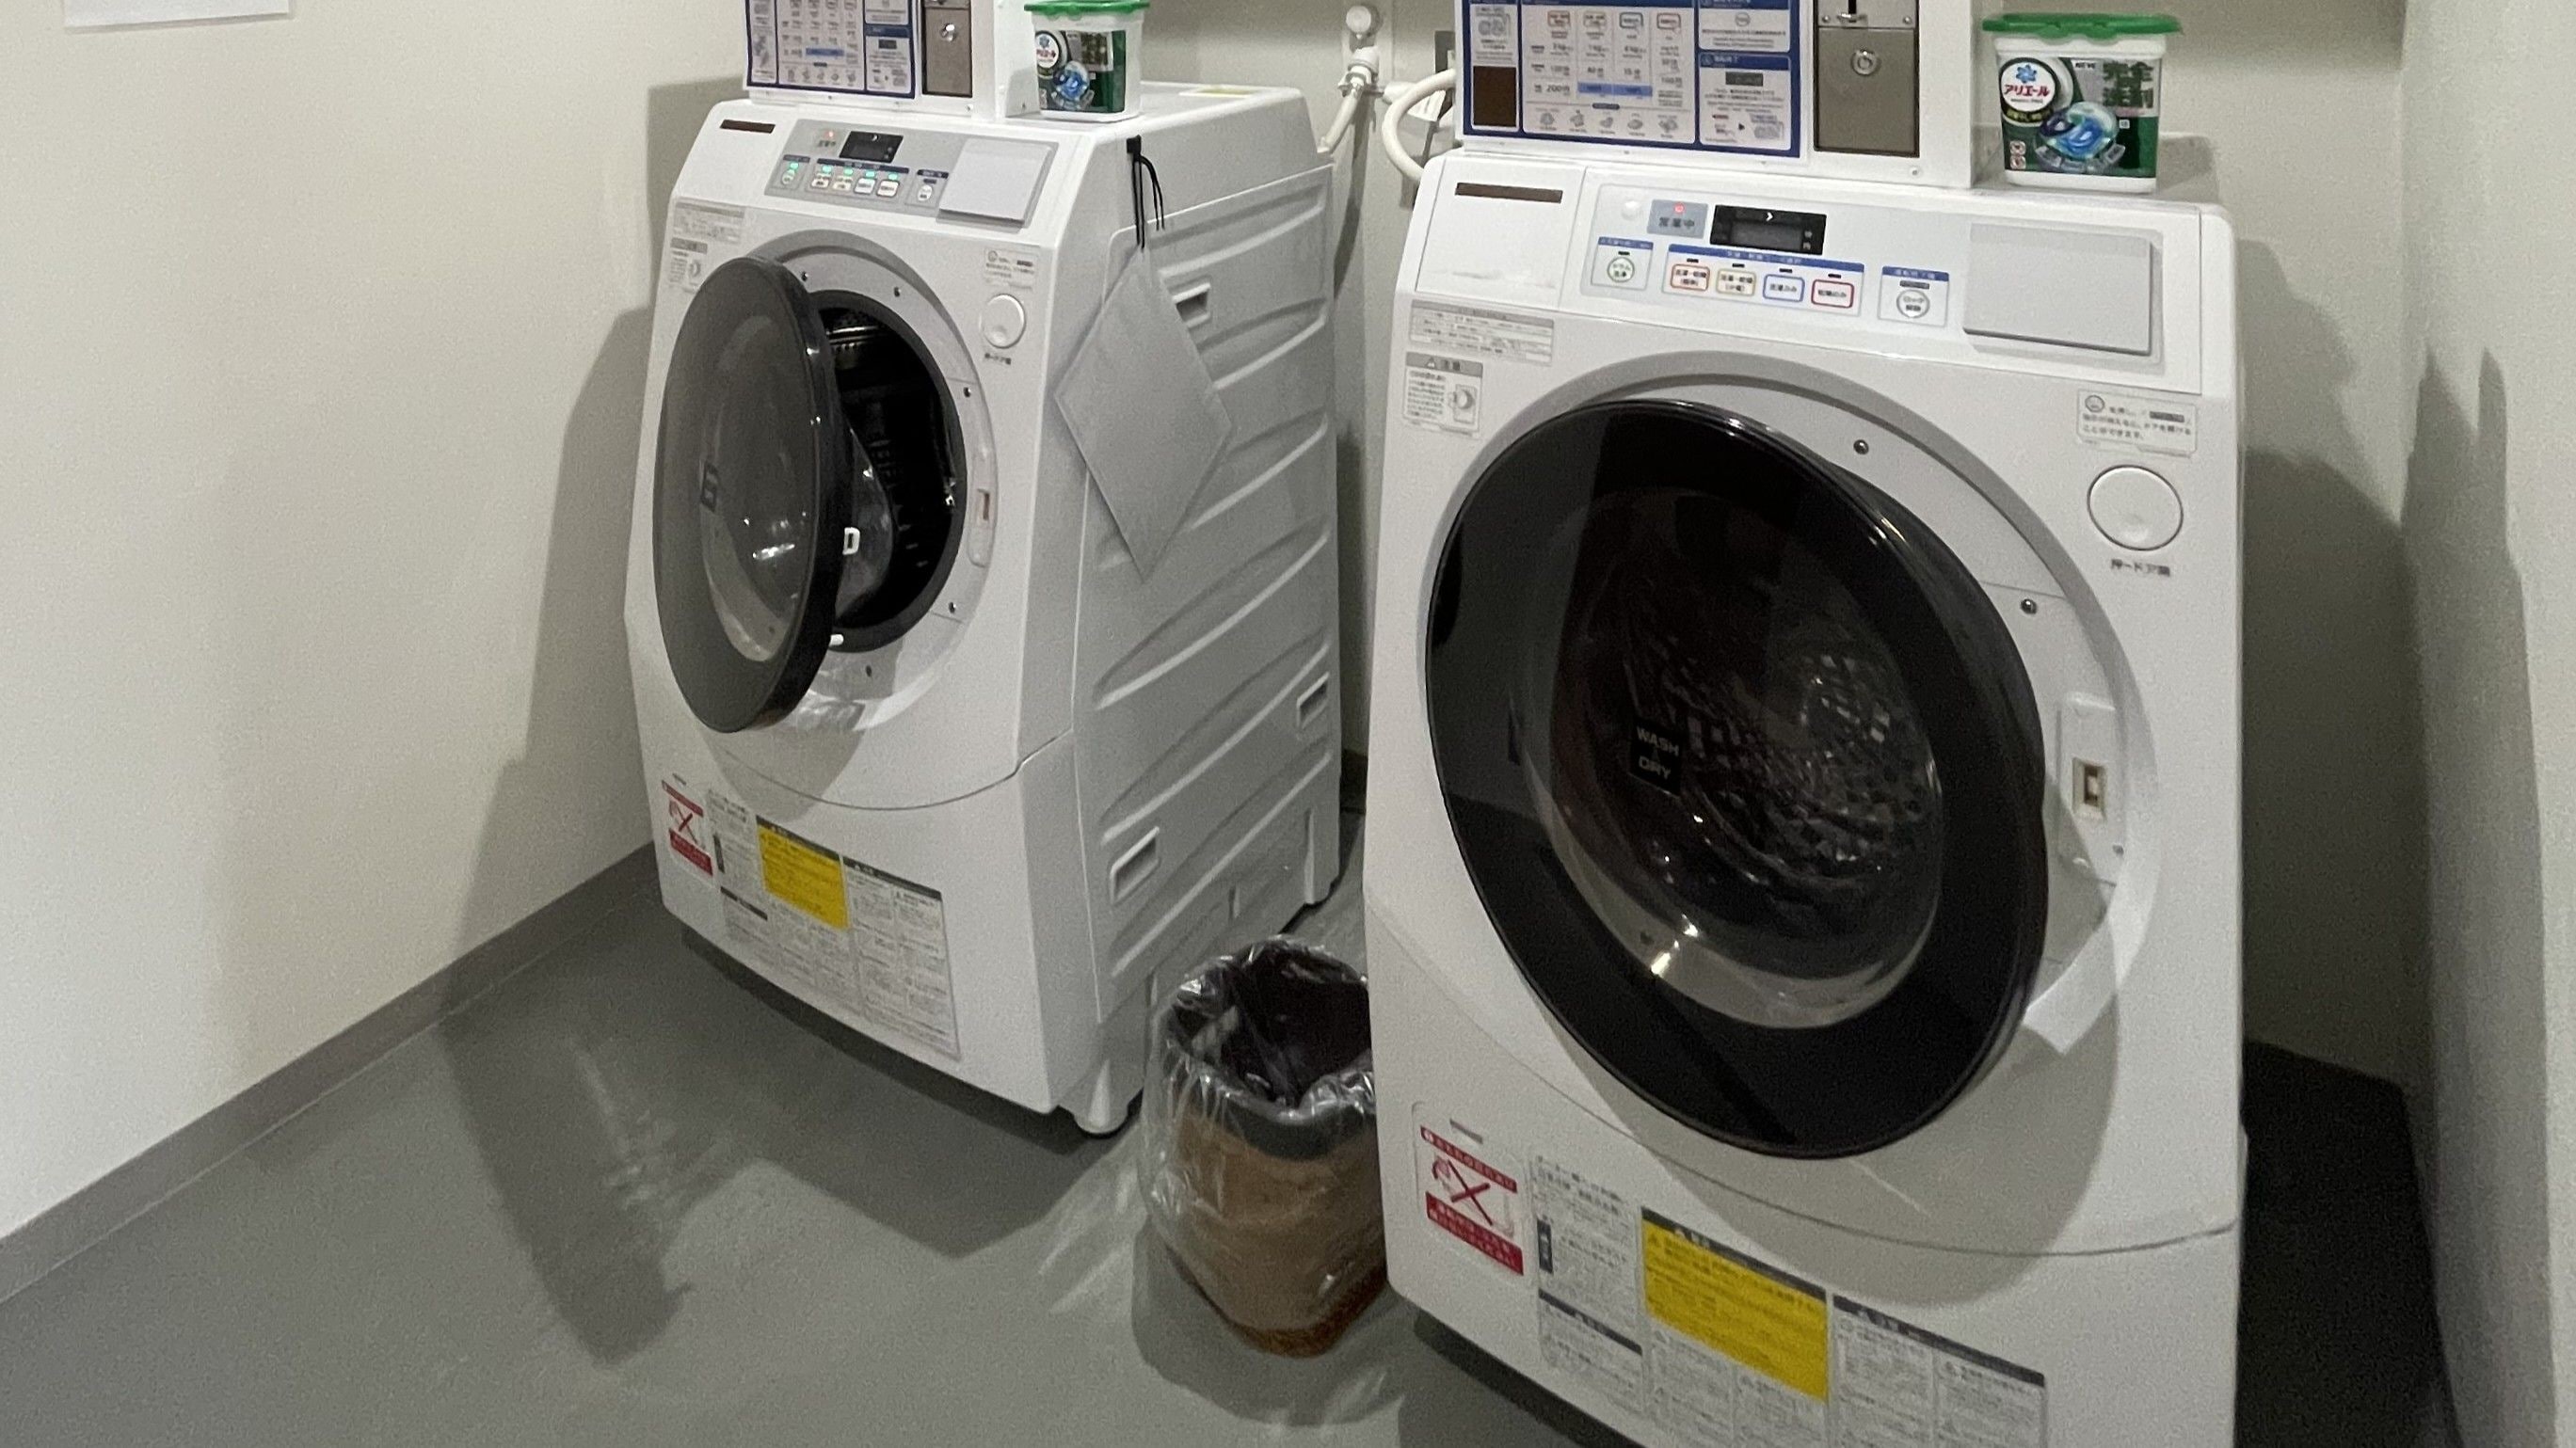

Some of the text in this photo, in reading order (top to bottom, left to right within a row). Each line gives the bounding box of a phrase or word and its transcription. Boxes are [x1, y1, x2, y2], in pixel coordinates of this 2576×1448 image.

[2004, 84, 2051, 97] アリエール
[1636, 725, 1680, 757] WASH
[1639, 756, 1672, 780] DRY
